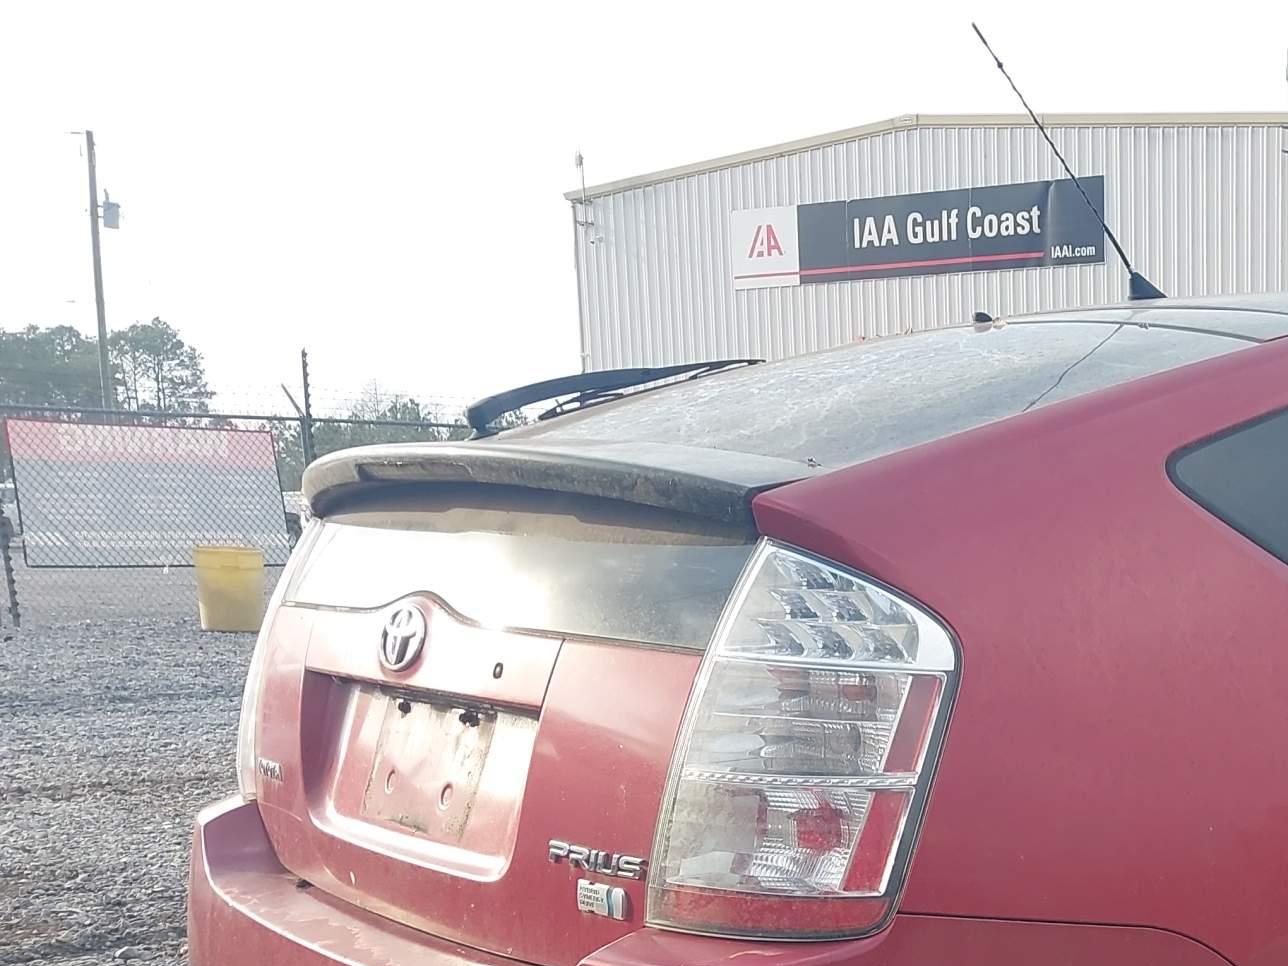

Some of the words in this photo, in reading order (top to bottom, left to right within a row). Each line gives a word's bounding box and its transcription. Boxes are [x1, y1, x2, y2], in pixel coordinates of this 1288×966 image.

[853, 215, 900, 249] IAA
[907, 208, 958, 244] Gulf
[967, 205, 1041, 239] Coast
[1050, 244, 1096, 259] IAAI.com
[548, 840, 649, 879] PRIUS
